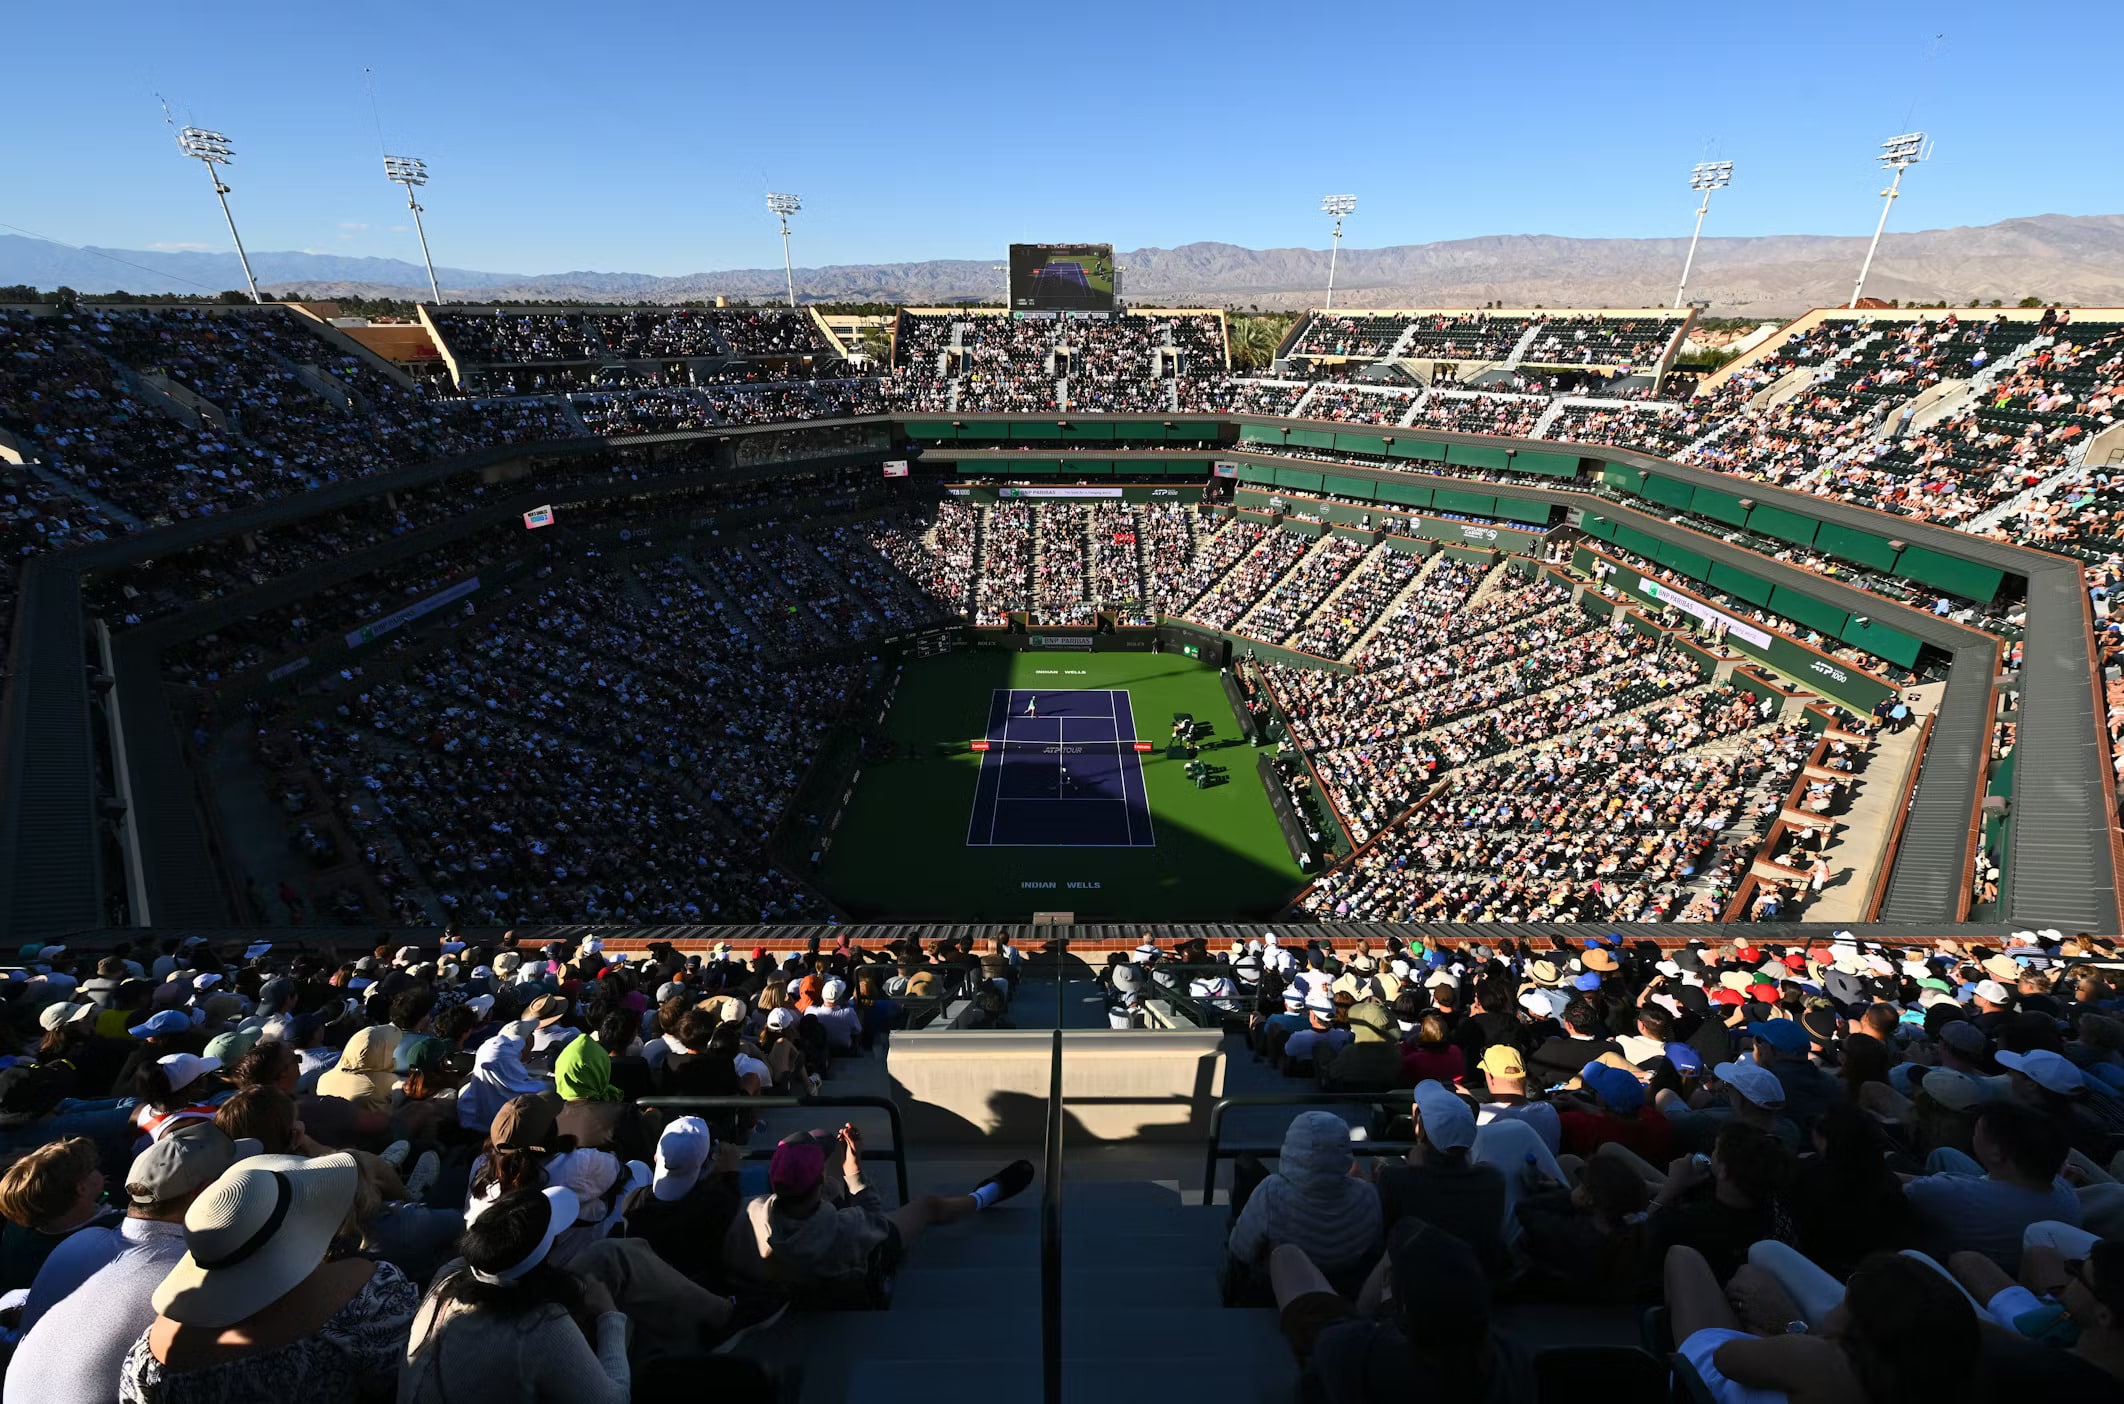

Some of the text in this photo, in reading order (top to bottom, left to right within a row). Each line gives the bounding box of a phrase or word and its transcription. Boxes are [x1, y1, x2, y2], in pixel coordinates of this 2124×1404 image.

[1658, 589, 1694, 609] BNP PARIBAS
[1810, 661, 1834, 675] ATP
[1831, 671, 1848, 683] 1000
[1043, 746, 1083, 754] ATP TOUR
[1021, 881, 1101, 889] INDIAN WELLS
